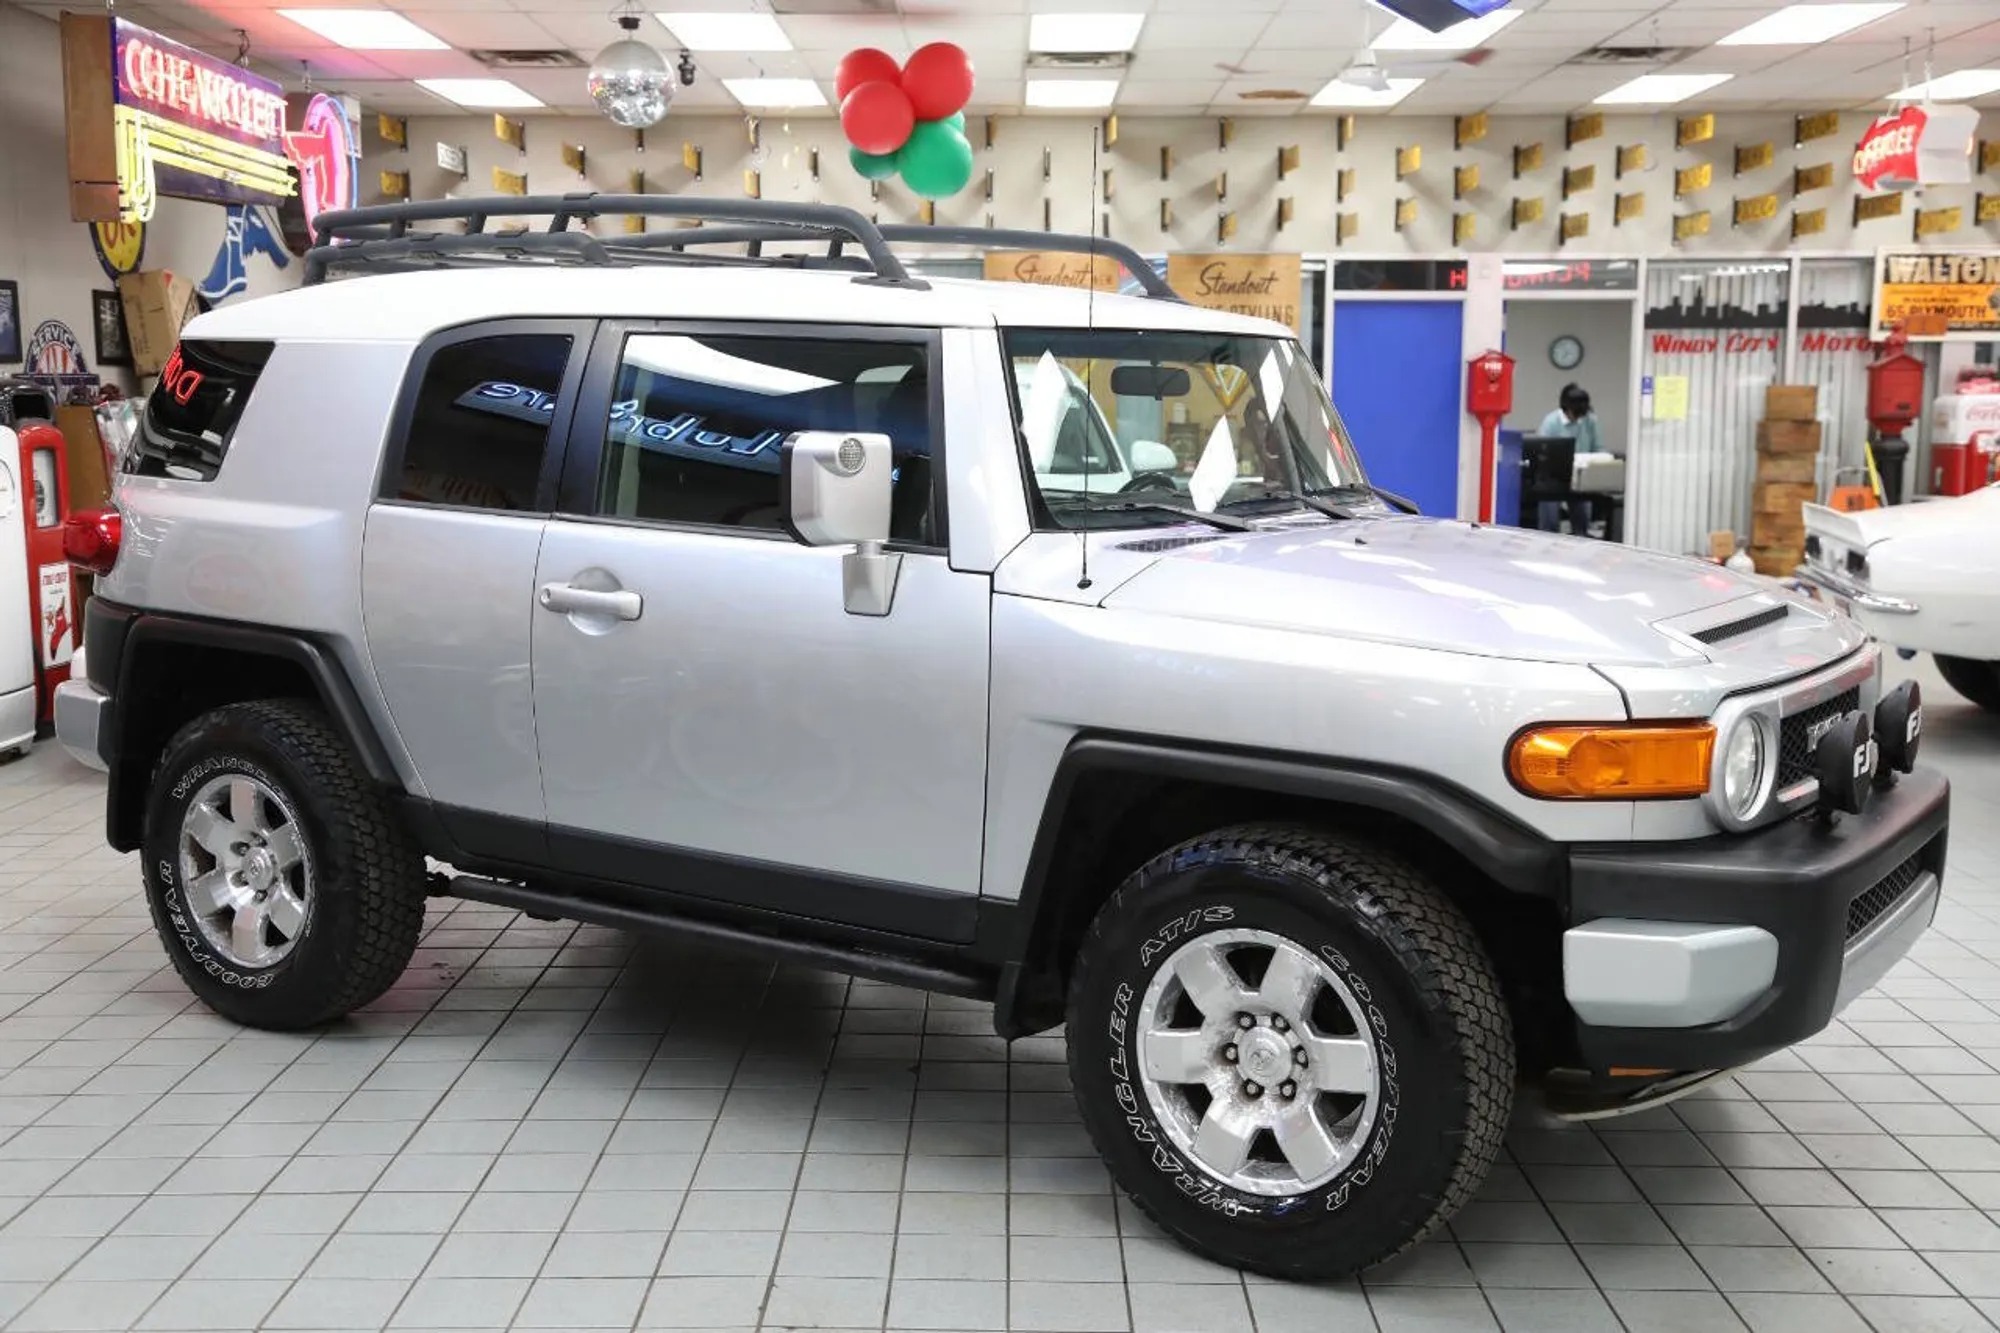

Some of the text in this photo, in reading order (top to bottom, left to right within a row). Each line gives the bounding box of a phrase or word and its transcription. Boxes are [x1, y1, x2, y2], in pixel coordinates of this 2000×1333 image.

[1195, 261, 1279, 297] Standout
[1652, 334, 1717, 352] WINDY
[1725, 333, 1779, 351] CITY
[1853, 743, 1871, 778] FJ
[160, 861, 274, 988] GOODYEAR
[1109, 982, 1239, 1217] WRANGLER
[1321, 944, 1399, 1211] GOODYEAR
